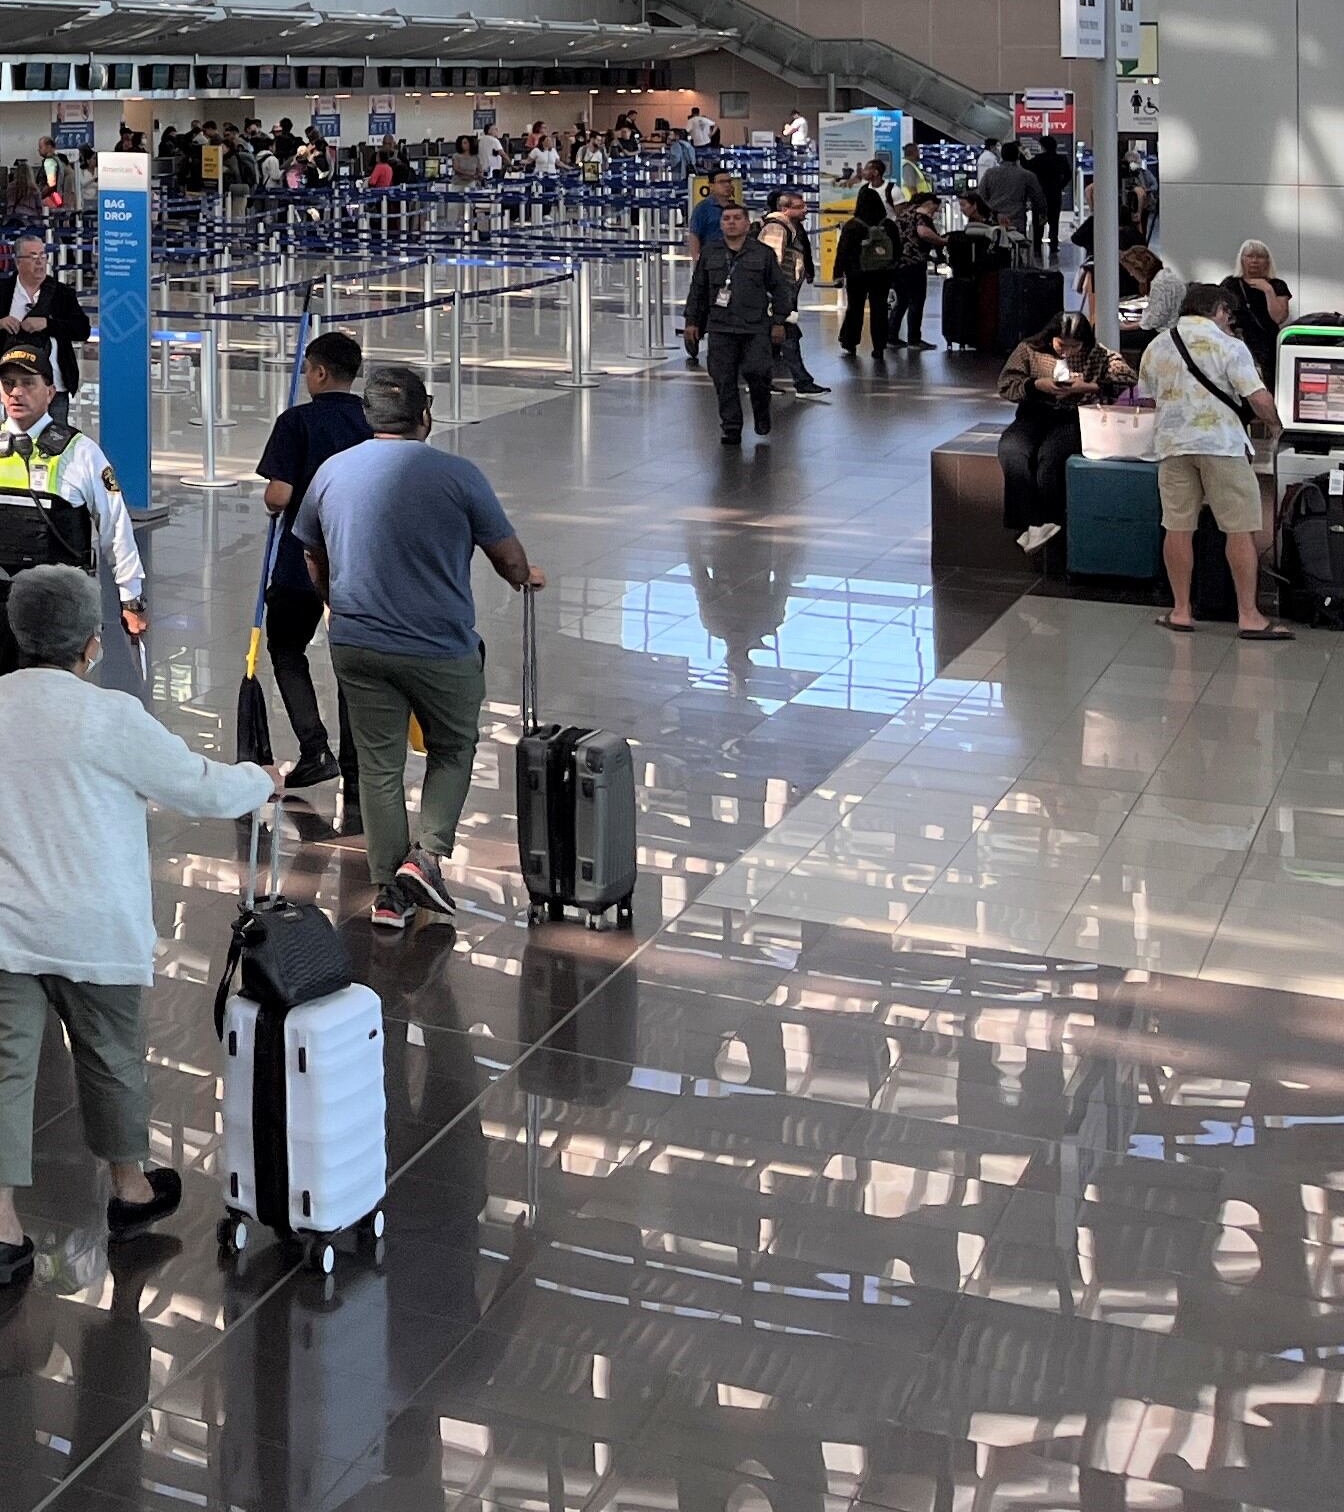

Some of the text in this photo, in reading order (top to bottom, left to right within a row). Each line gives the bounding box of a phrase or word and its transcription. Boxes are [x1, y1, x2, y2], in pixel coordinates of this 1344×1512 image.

[1019, 121, 1067, 129] PRIOITY
[104, 199, 126, 209] BAG
[104, 211, 133, 221] DROP
